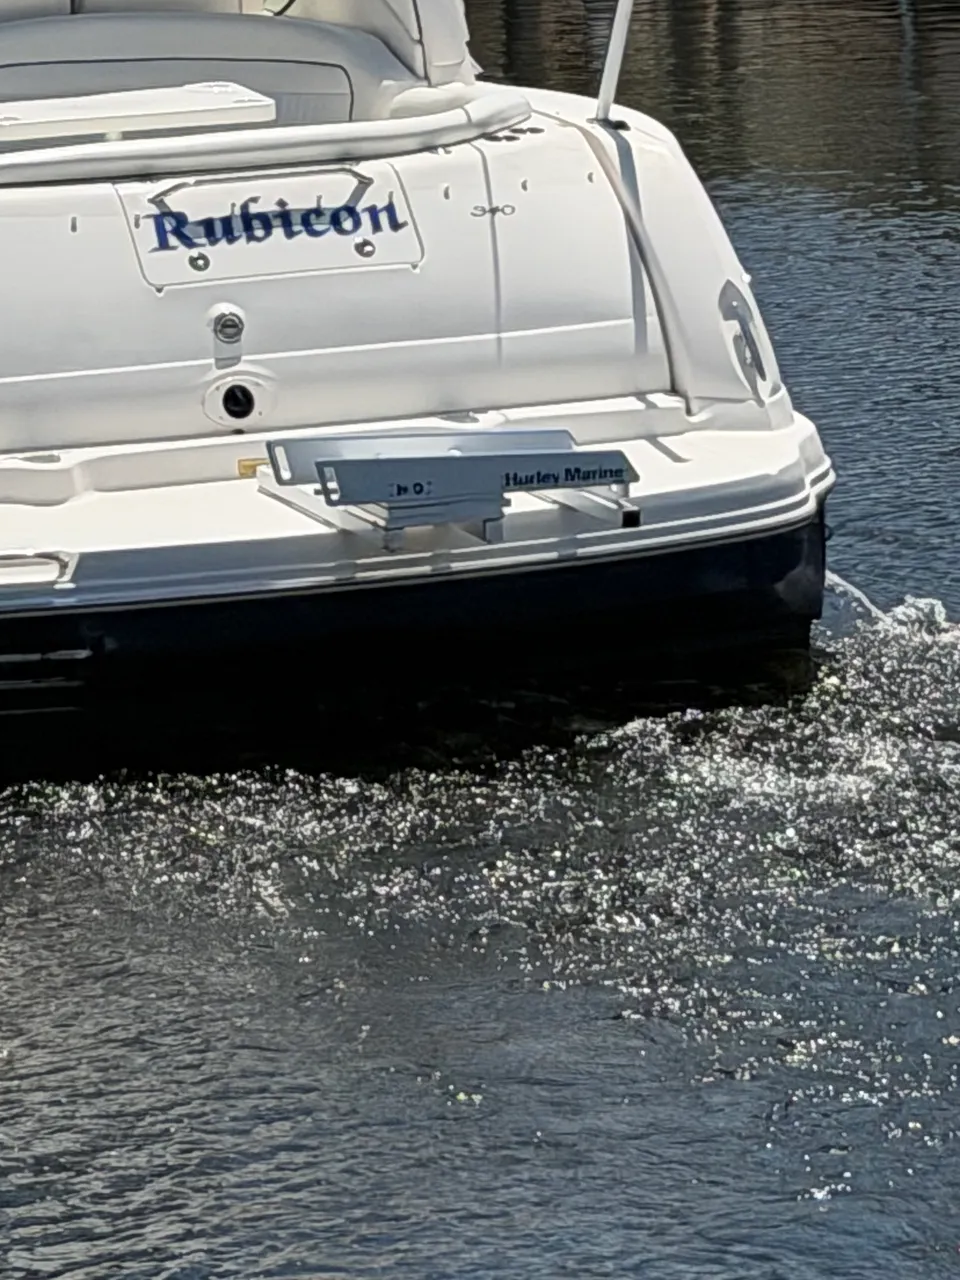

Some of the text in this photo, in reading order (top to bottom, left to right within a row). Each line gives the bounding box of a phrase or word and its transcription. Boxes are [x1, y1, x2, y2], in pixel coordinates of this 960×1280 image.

[142, 191, 409, 253] Rubicon
[504, 465, 625, 487] Hurley Marine
